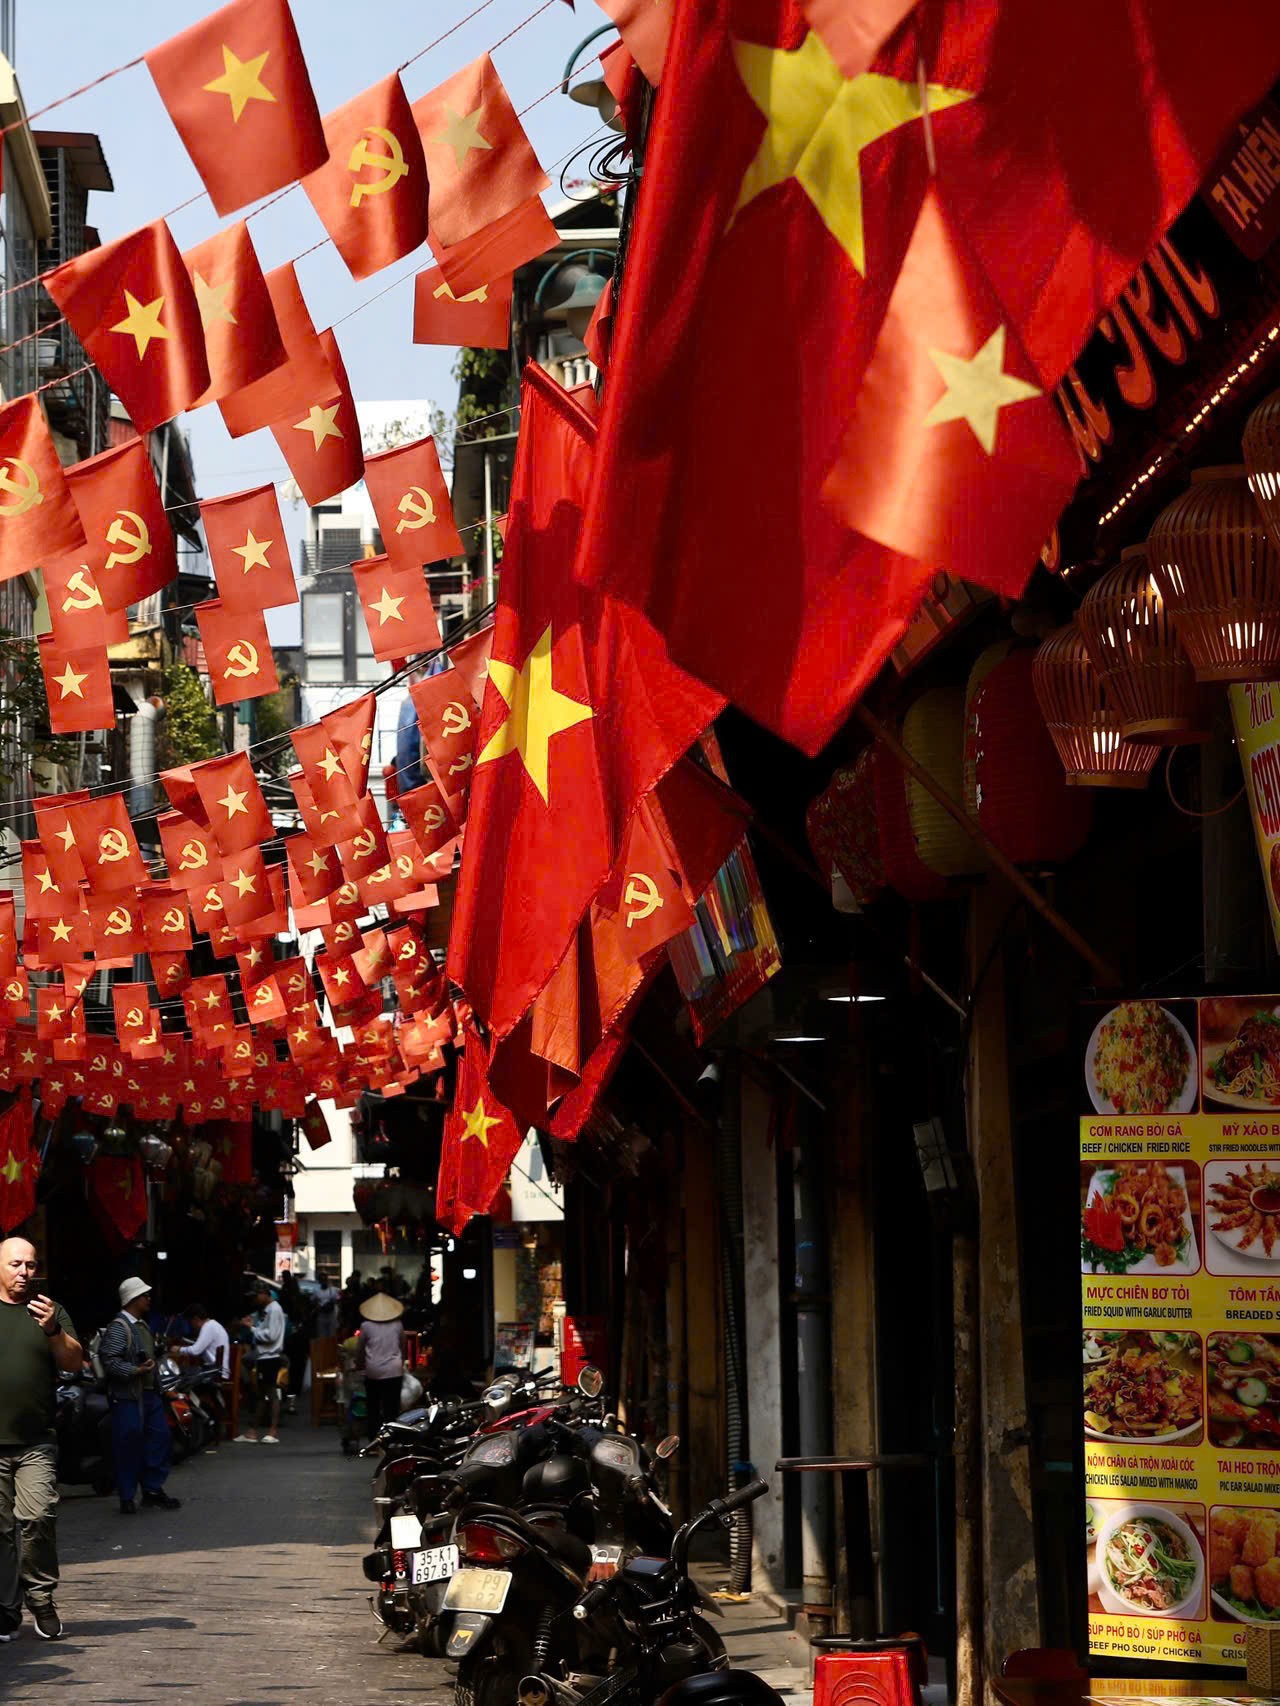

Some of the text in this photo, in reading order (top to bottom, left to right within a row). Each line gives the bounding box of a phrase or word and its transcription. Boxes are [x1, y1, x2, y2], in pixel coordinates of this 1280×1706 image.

[1090, 1124, 1112, 1137] CƠM
[1115, 1125, 1144, 1137] RANG
[1082, 1143, 1102, 1153] BEEF
[1108, 1143, 1143, 1152] CHICKEN
[1146, 1143, 1170, 1153] FRIED
[1171, 1143, 1190, 1152] RICE
[1208, 1144, 1222, 1152] STIR
[1222, 1144, 1240, 1152] FRIED
[1240, 1144, 1268, 1152] NOODLES
[1087, 1284, 1190, 1301] MỰC CHIÊN BƠ TỎI
[1228, 1286, 1256, 1301] TÔM
[1084, 1305, 1192, 1318] FRIED SQUID WITH GARLIC BUTTER
[1226, 1310, 1273, 1320] BREADED
[1106, 1455, 1127, 1468] CHÂN
[1139, 1456, 1159, 1471] TRỘN
[1160, 1457, 1178, 1471] XOÀI
[1179, 1457, 1195, 1471] CÓC
[1217, 1460, 1232, 1472] TAI
[1235, 1461, 1254, 1474] HEO
[1085, 1474, 1198, 1490] CHICKEN LEG SALAD MIXED WITH MANGO
[1230, 1480, 1242, 1491] EAR
[1243, 1481, 1263, 1492] SALAD
[420, 1547, 452, 1566] 35-K1
[416, 1562, 455, 1582] 697.81
[1088, 1622, 1104, 1635] SÚP
[1127, 1624, 1140, 1638] BÒ
[1147, 1627, 1164, 1641] SÚP
[1167, 1626, 1186, 1643] PHỞ
[1188, 1628, 1202, 1644] GÀ
[1088, 1641, 1110, 1650] BEEF
[1112, 1643, 1130, 1651] PHO
[1132, 1644, 1156, 1654] SOUP
[1163, 1647, 1202, 1658] CHICKEN
